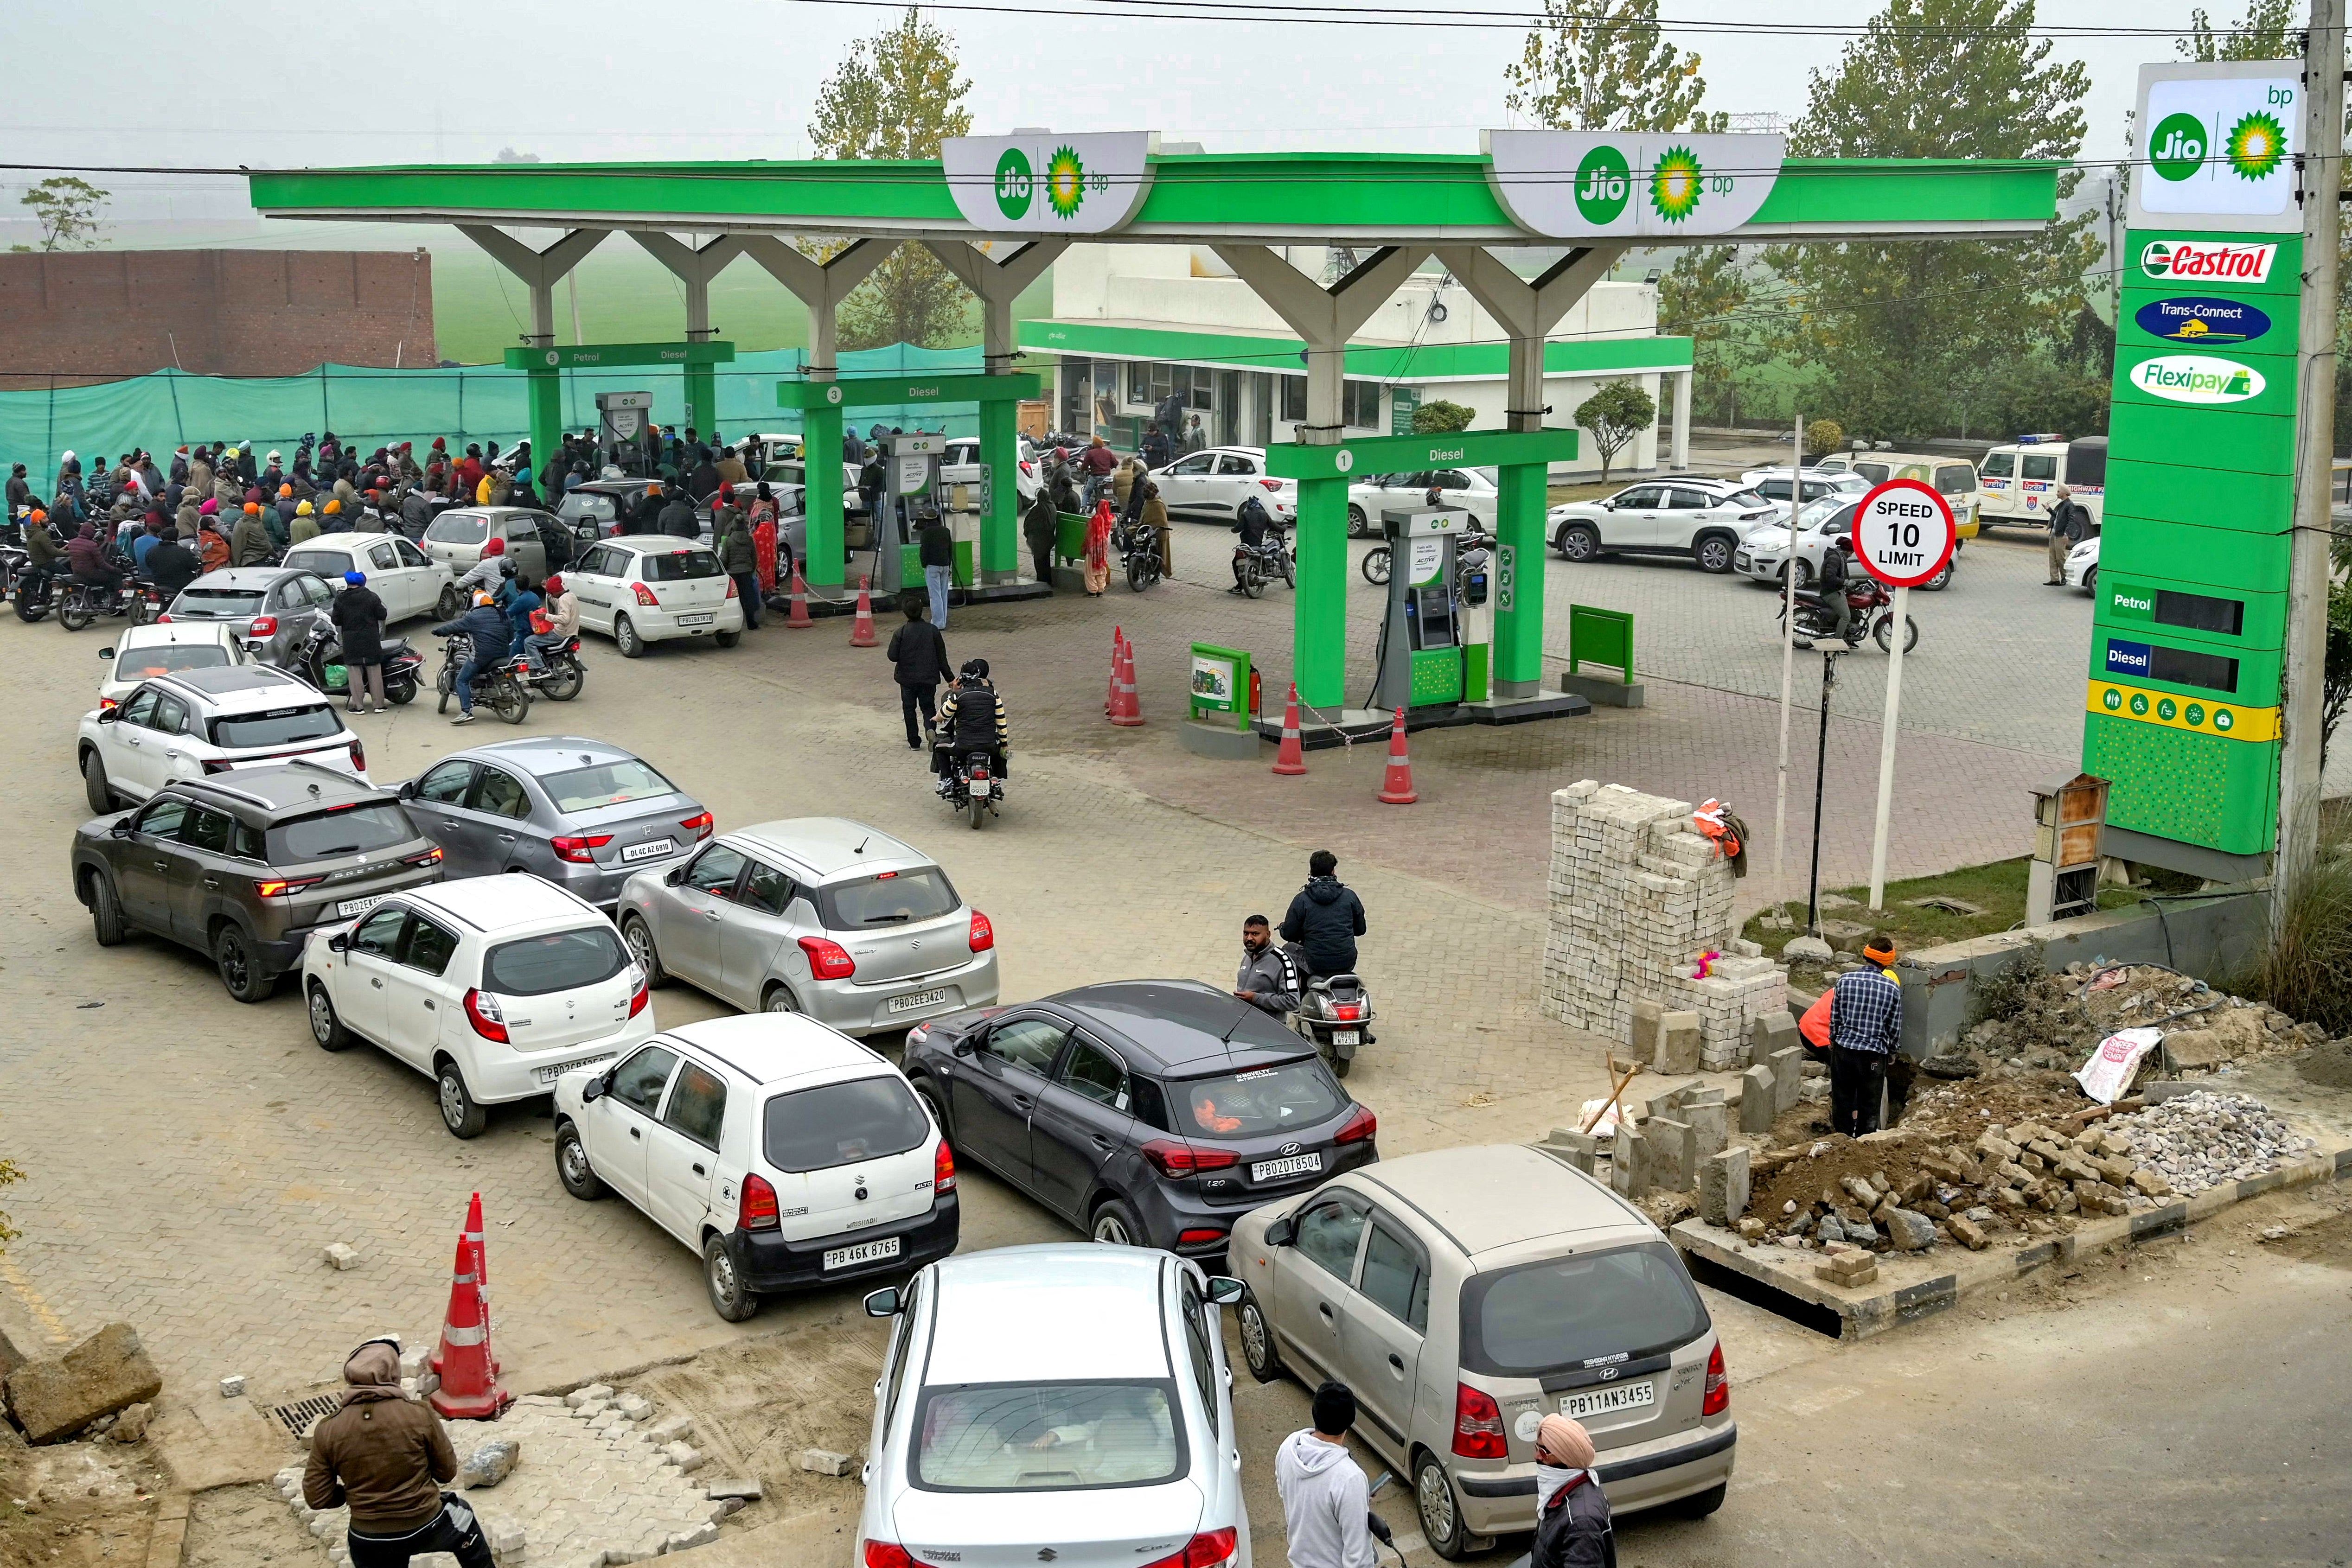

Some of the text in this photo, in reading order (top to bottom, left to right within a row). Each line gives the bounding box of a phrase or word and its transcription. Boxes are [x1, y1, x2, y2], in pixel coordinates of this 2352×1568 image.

[2268, 85, 2293, 108] bp
[2156, 130, 2201, 160] Jio
[999, 166, 1029, 198] Jio
[1092, 170, 1108, 195] bp
[1580, 166, 1624, 201] Jio
[1712, 172, 1734, 198] bp
[2172, 245, 2266, 277] Castrol
[2160, 302, 2243, 319] Trans-Connect
[549, 350, 687, 363] 5 Petrol Diesel
[2144, 364, 2230, 395] Flexipay
[831, 387, 939, 400] 3 Diesel
[1341, 448, 1464, 467] 1 Diesel
[1876, 501, 1933, 518] SPEED
[1888, 523, 1919, 548] 10
[1879, 550, 1924, 567] LIMIT
[2114, 594, 2151, 611] Petrol
[2109, 650, 2147, 667] Diesel
[656, 843, 669, 852] 6910
[894, 990, 944, 1009] PB02EE3420
[1242, 1069, 1269, 1078] NOVELTY
[1259, 1154, 1320, 1177] PB02DT8504
[832, 1251, 845, 1265] PB
[849, 1246, 868, 1261] 46K
[871, 1240, 897, 1256] 8765
[1608, 1351, 1629, 1361] HYUNDAI
[1515, 1402, 1540, 1412] eRLX
[1570, 1385, 1652, 1415] PB11AN3455
